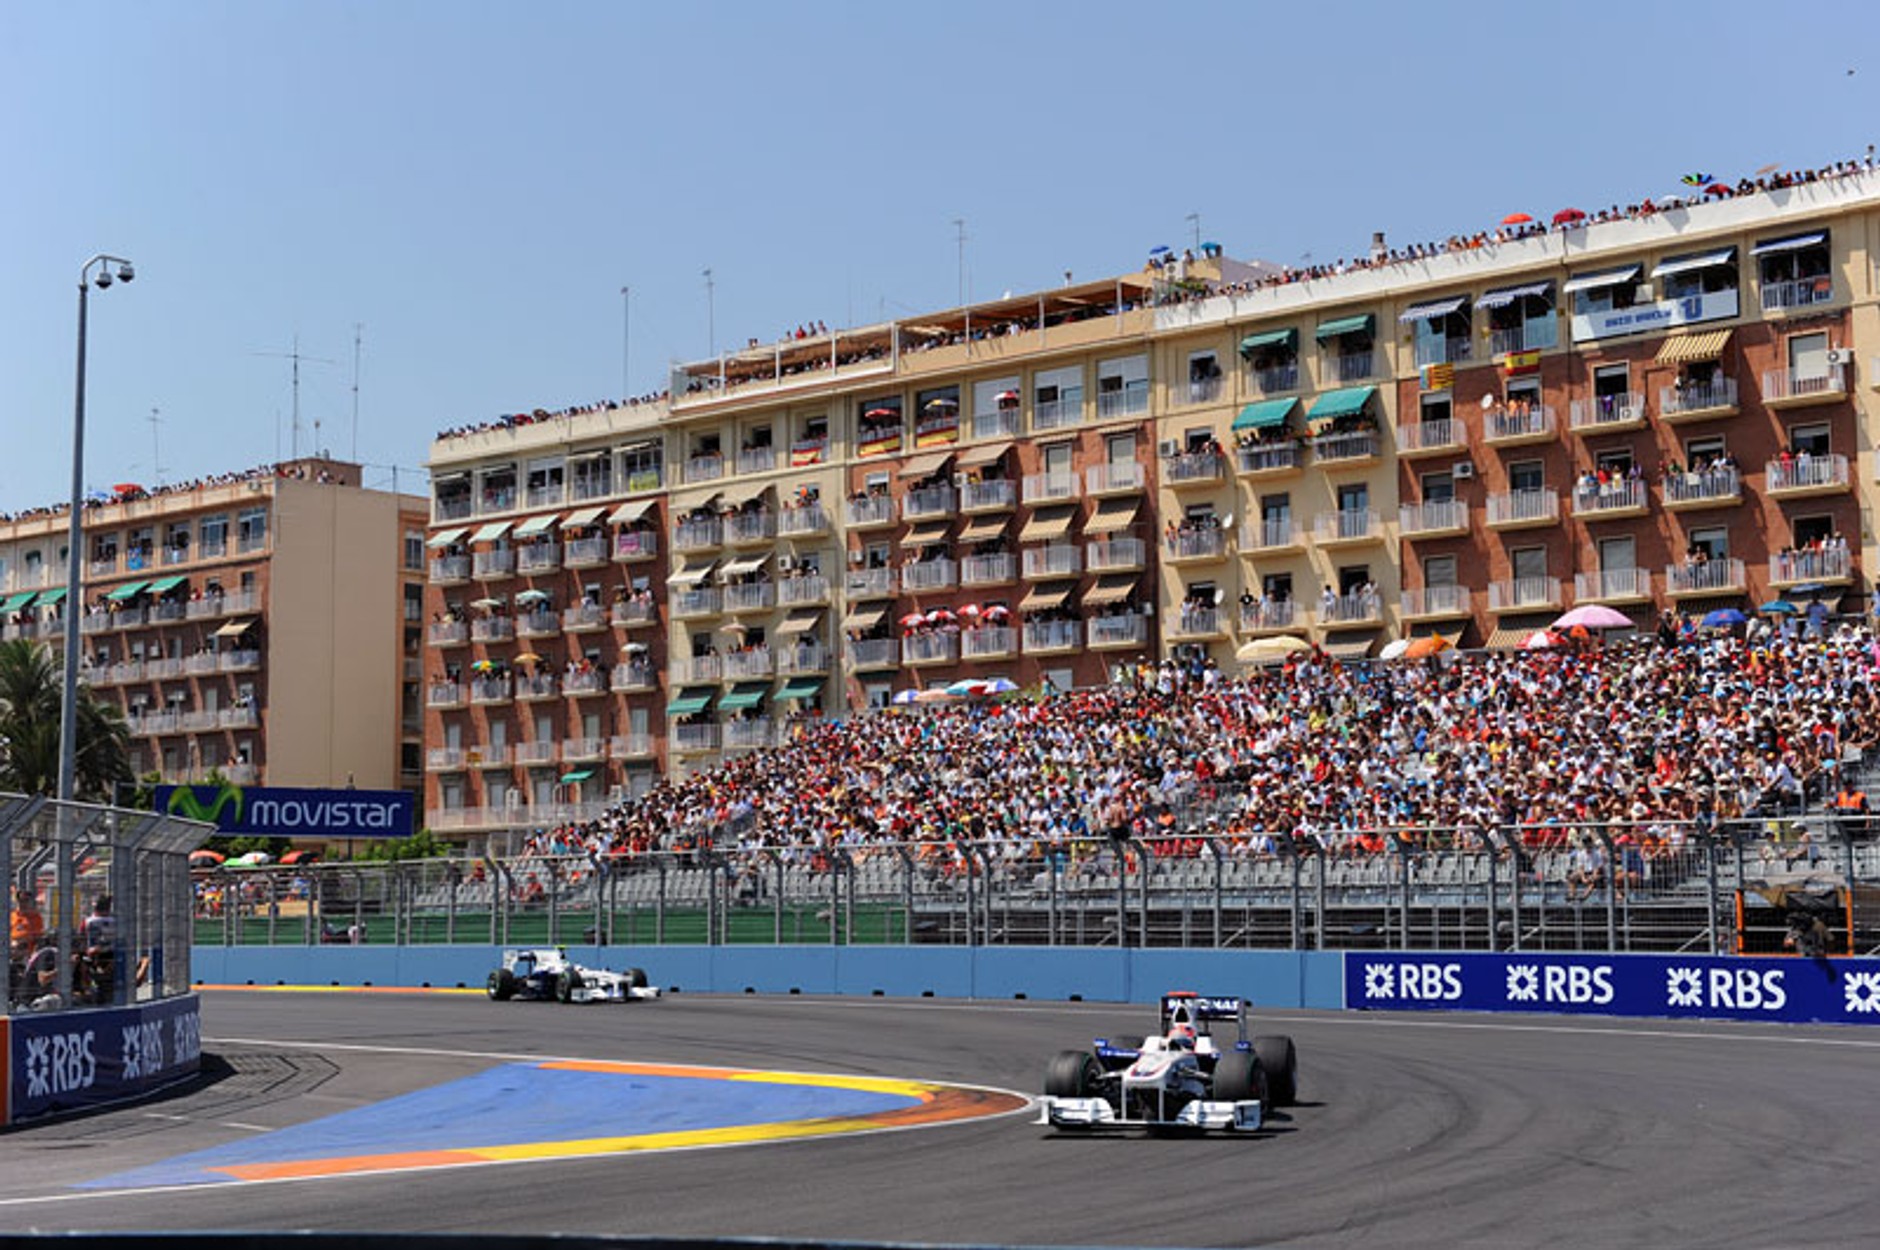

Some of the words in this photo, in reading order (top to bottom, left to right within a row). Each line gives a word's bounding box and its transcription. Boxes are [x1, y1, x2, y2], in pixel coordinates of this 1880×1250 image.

[251, 800, 402, 827] movistar
[1167, 998, 1240, 1011] PONAS
[1400, 963, 1463, 1001] RBS
[1545, 965, 1614, 1004] RBS
[1709, 967, 1787, 1010] RBS
[52, 1030, 96, 1094] RBS
